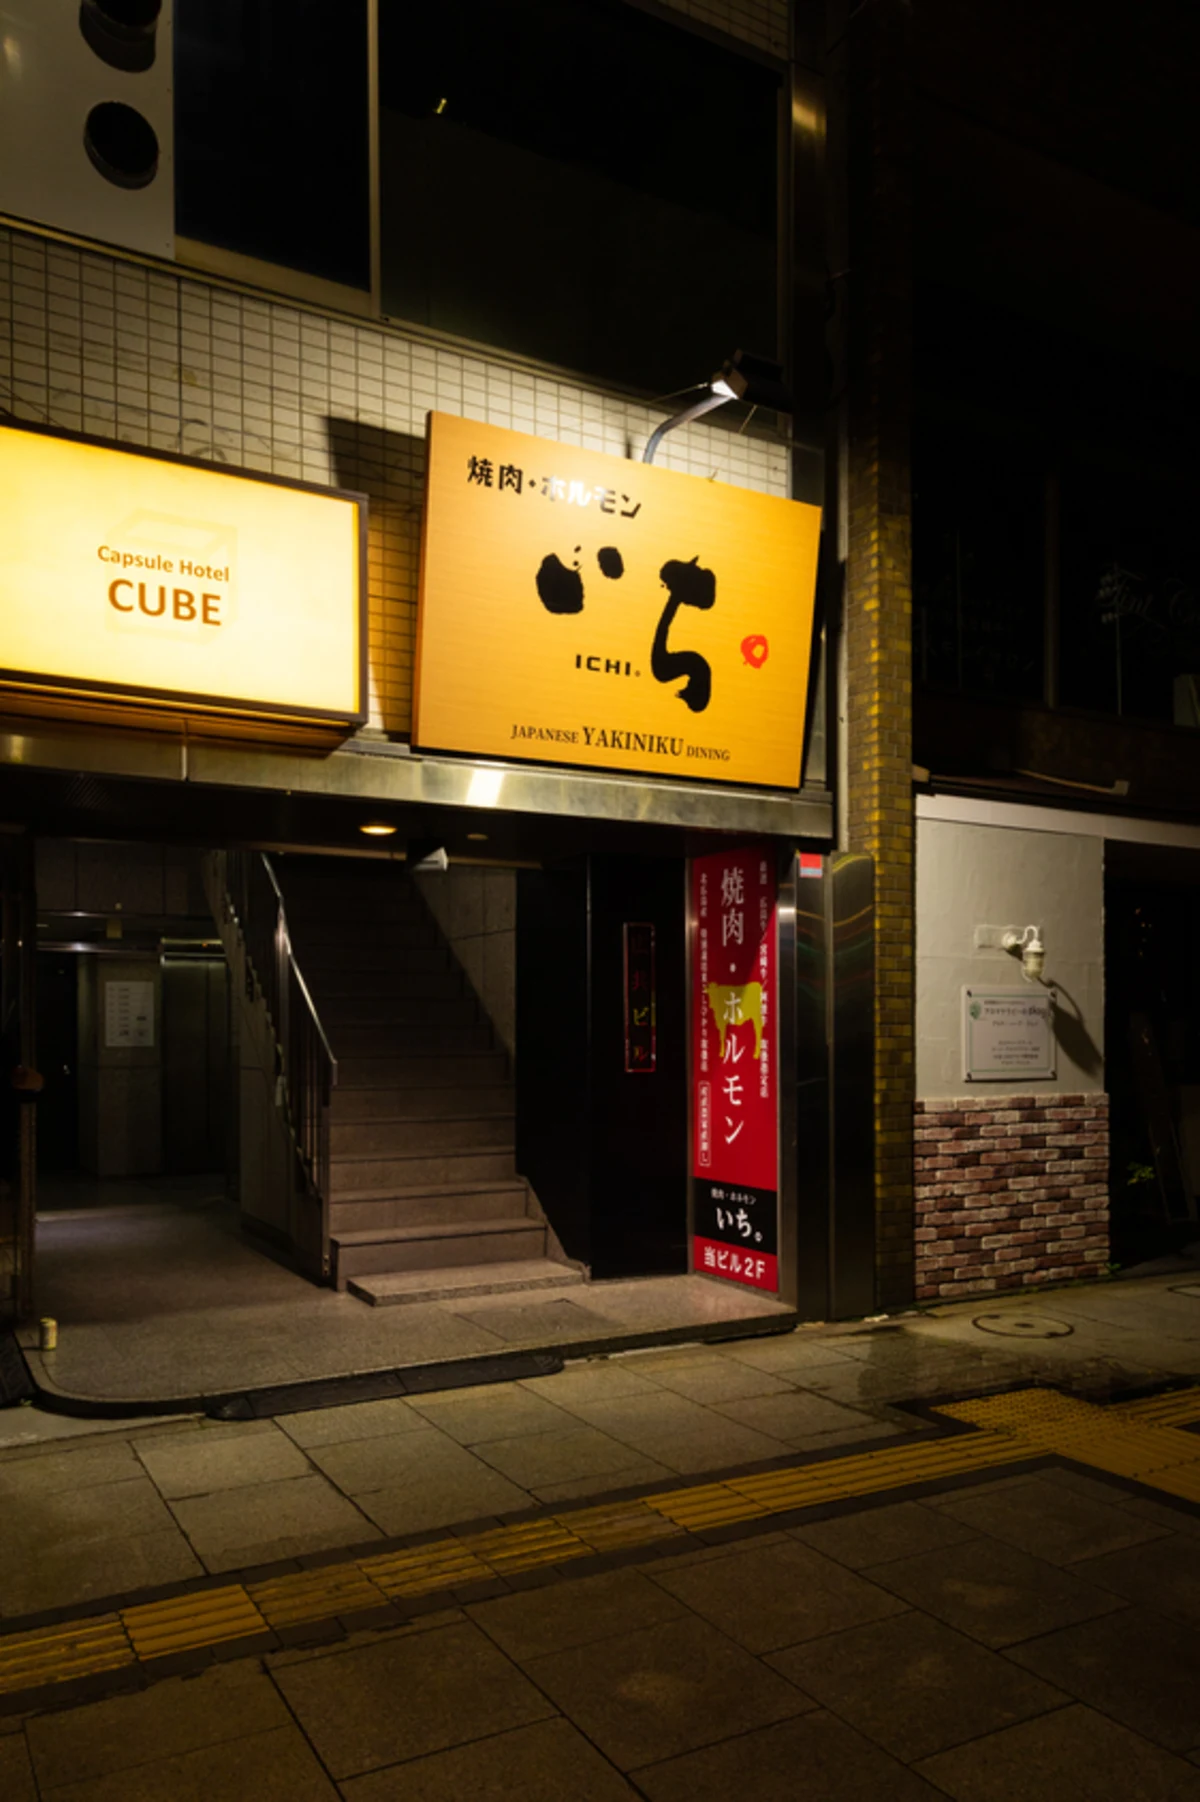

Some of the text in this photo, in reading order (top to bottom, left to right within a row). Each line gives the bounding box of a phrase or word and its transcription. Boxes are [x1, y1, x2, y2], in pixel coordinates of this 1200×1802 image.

[97, 545, 230, 582] Capsule Hotel
[108, 578, 222, 626] CUBE
[510, 724, 731, 762] JAPANESE YAKINIKU DINING
[720, 866, 746, 1145] 焼肉・ホルモン
[704, 1245, 766, 1280] 当ビル2F
